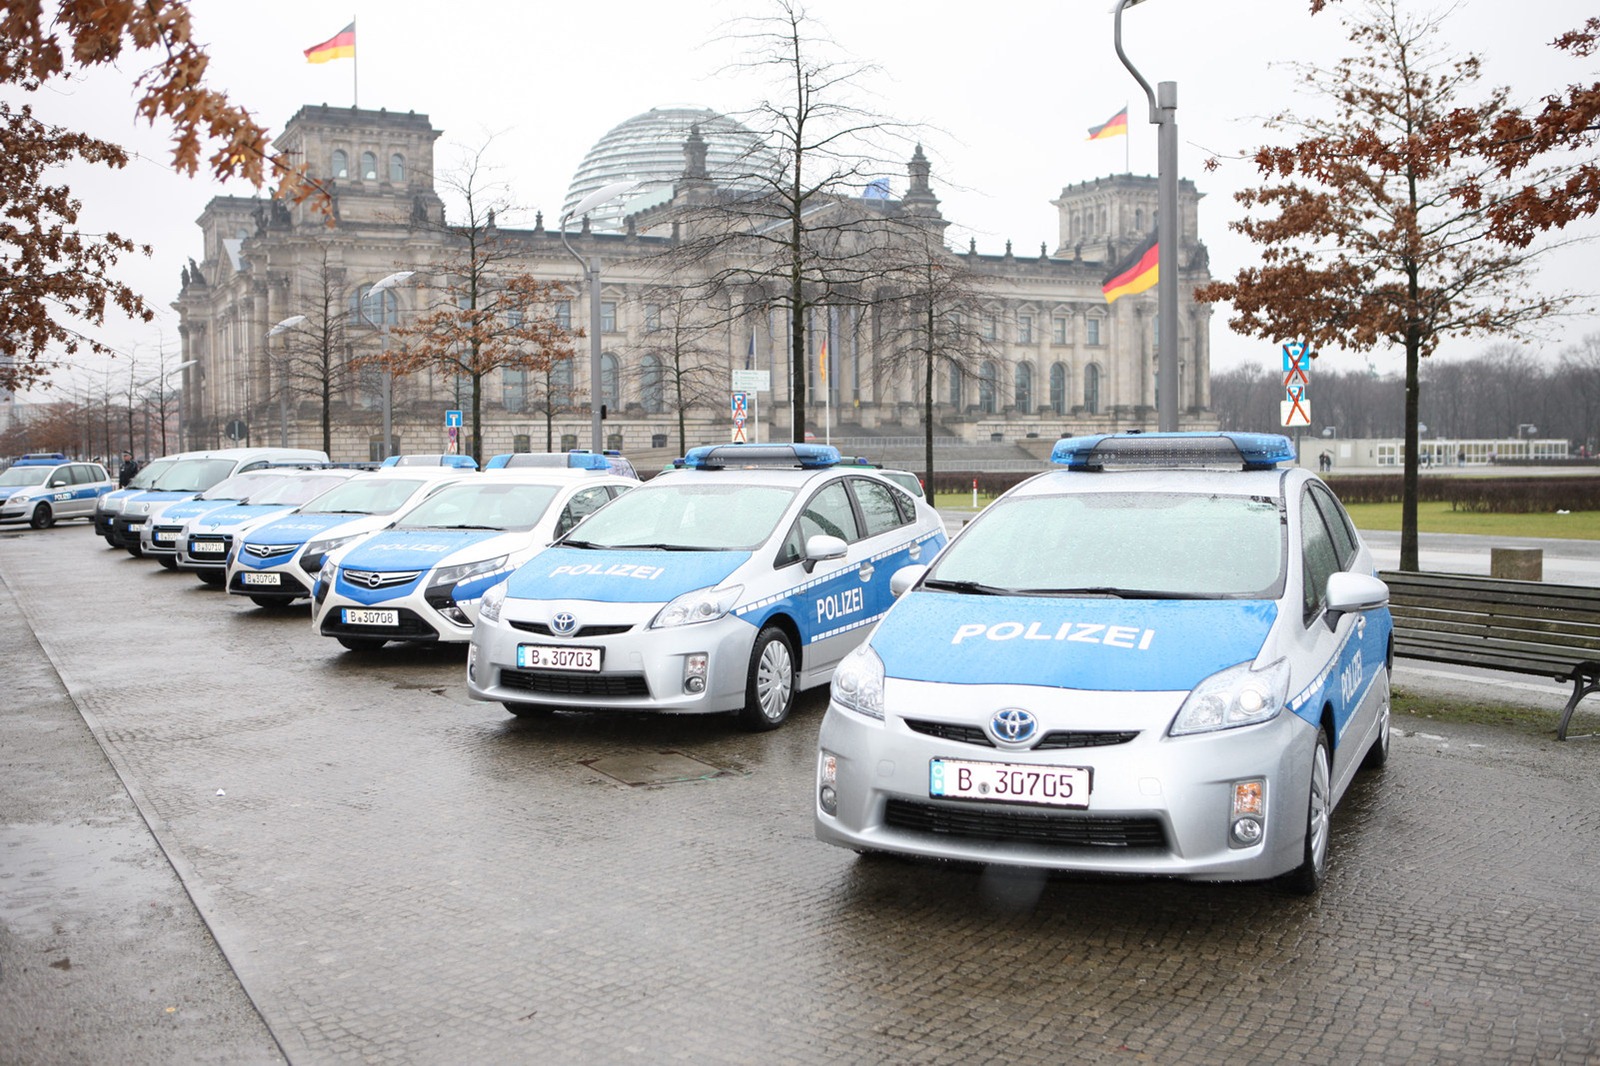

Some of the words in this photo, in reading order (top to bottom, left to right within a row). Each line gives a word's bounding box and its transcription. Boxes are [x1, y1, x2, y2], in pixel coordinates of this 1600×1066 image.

[368, 543, 450, 553] POLIZEI
[247, 573, 252, 583] B
[256, 574, 278, 584] 30706
[548, 563, 665, 580] POLIZEI
[816, 586, 864, 624] POLIZEI
[350, 611, 357, 623] B
[363, 612, 394, 624] 30708
[950, 621, 1155, 650] POLIZEI
[532, 650, 541, 665] B
[551, 651, 593, 668] 30703
[1341, 648, 1363, 711] POLIZEI
[958, 768, 973, 791] B
[994, 770, 1073, 798] 30705
